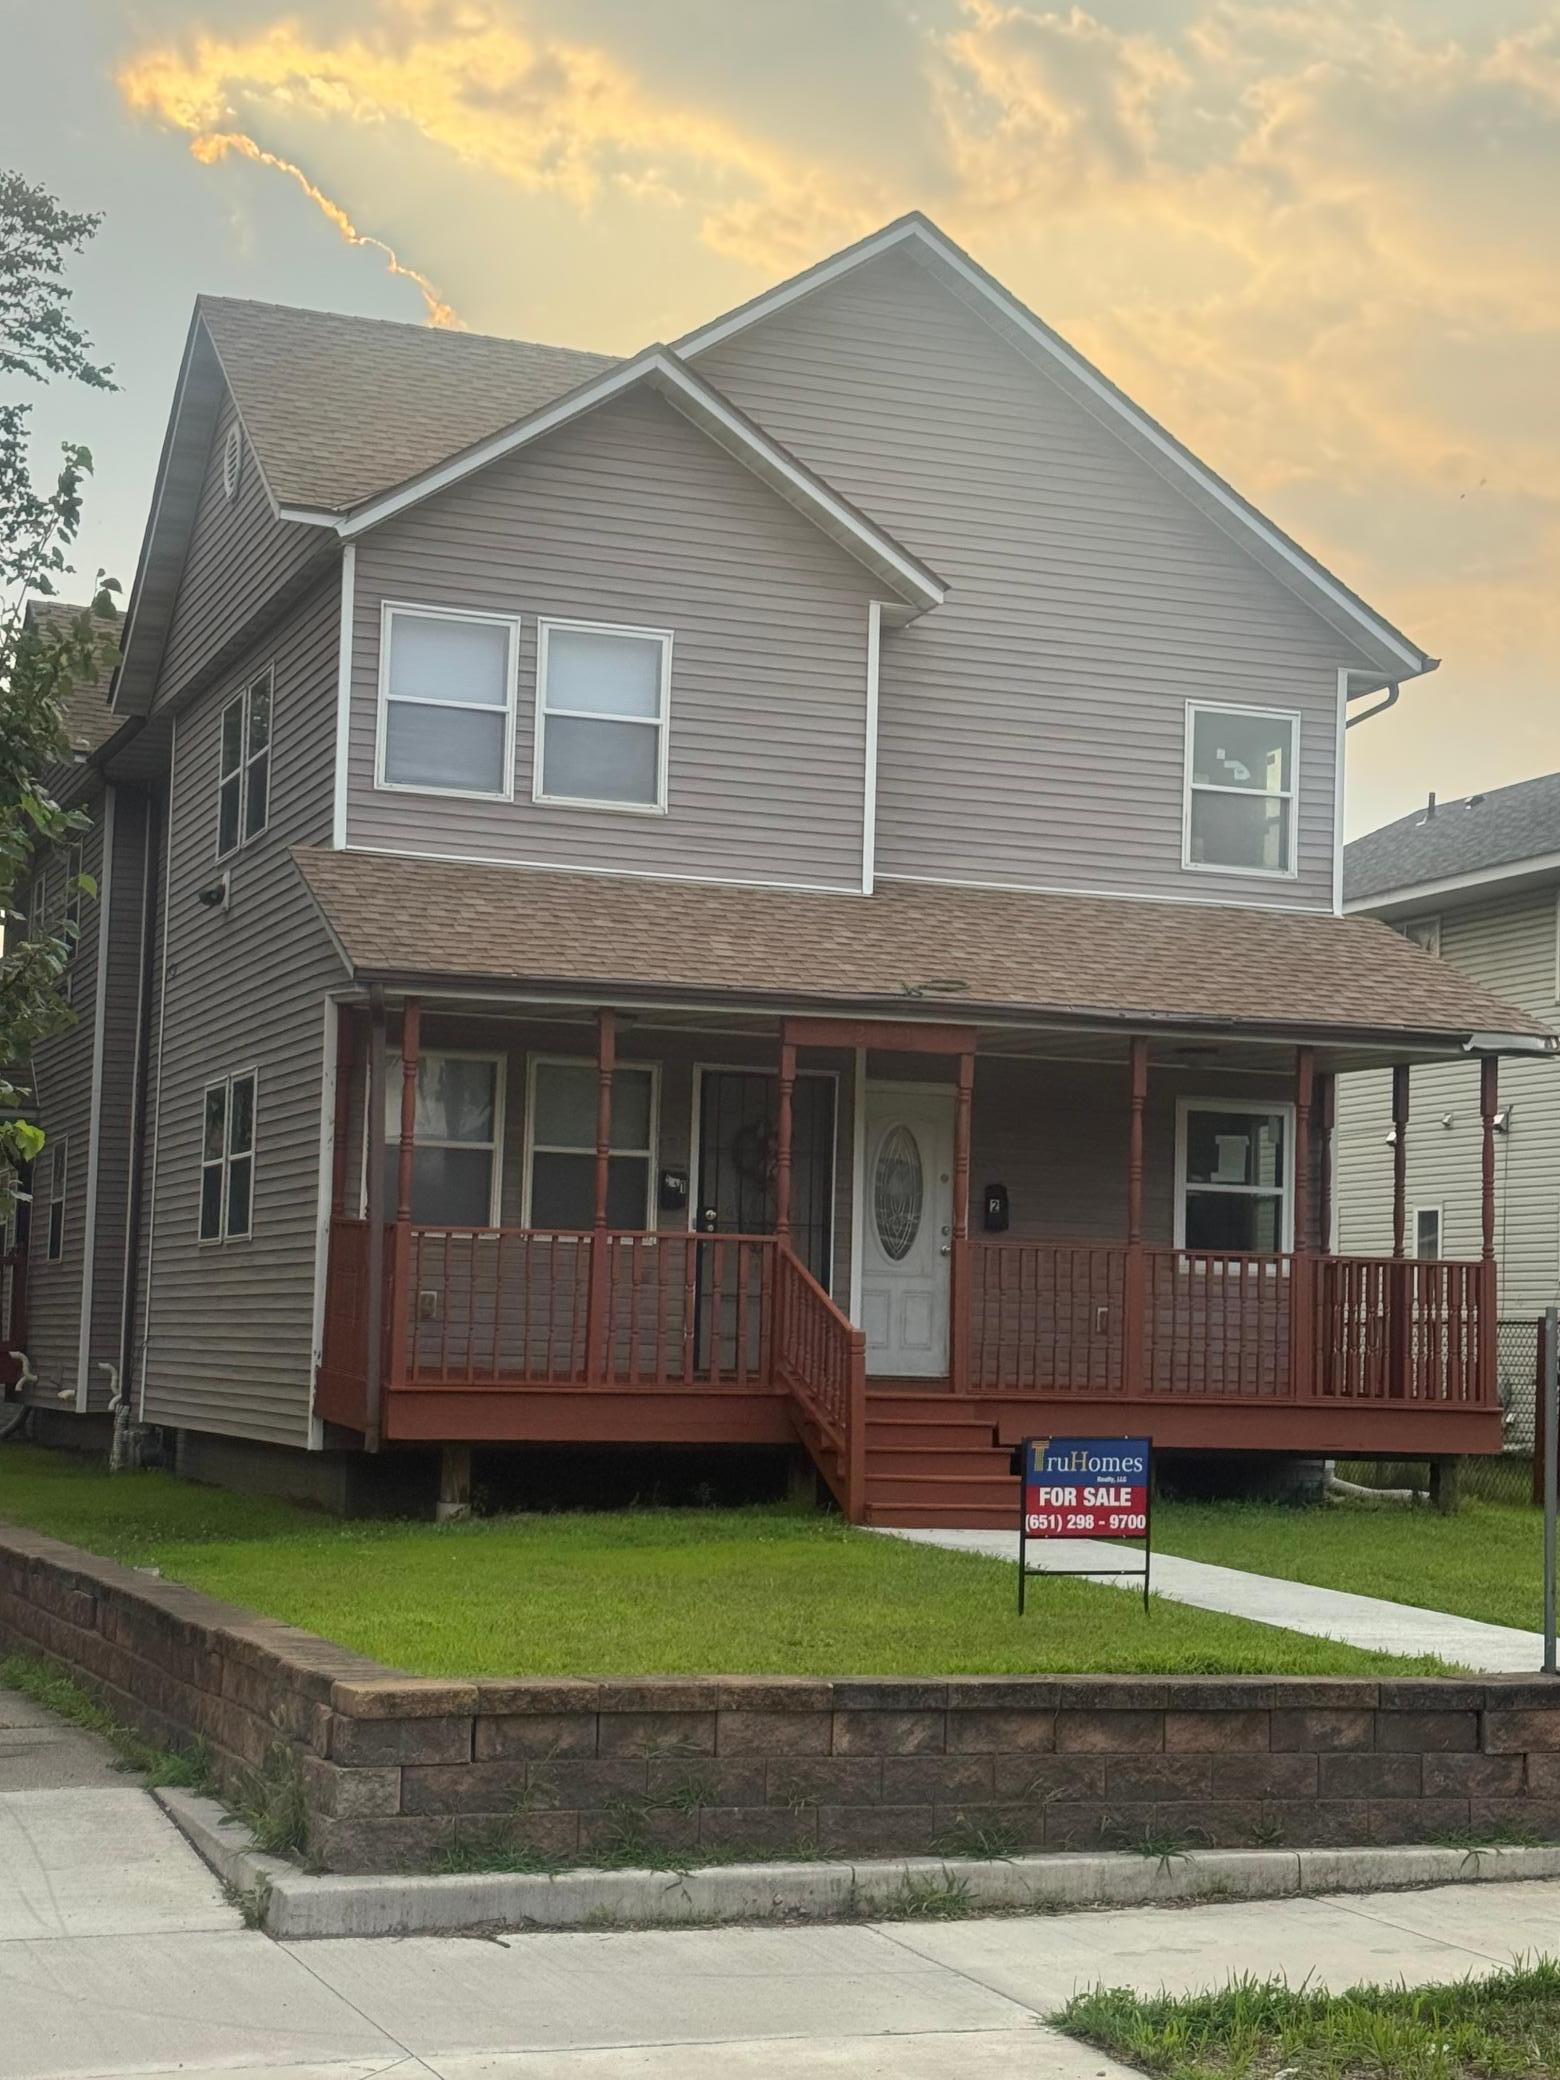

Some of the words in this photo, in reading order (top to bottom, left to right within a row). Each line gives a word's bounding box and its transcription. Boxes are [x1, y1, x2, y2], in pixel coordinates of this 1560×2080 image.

[1032, 1440, 1143, 1472] TruHomes
[1039, 1487, 1077, 1506] FOR
[1083, 1487, 1131, 1506] SALE
[1025, 1514, 1062, 1532] (651)
[1066, 1515, 1094, 1529] 298
[1109, 1515, 1146, 1529] 9700
